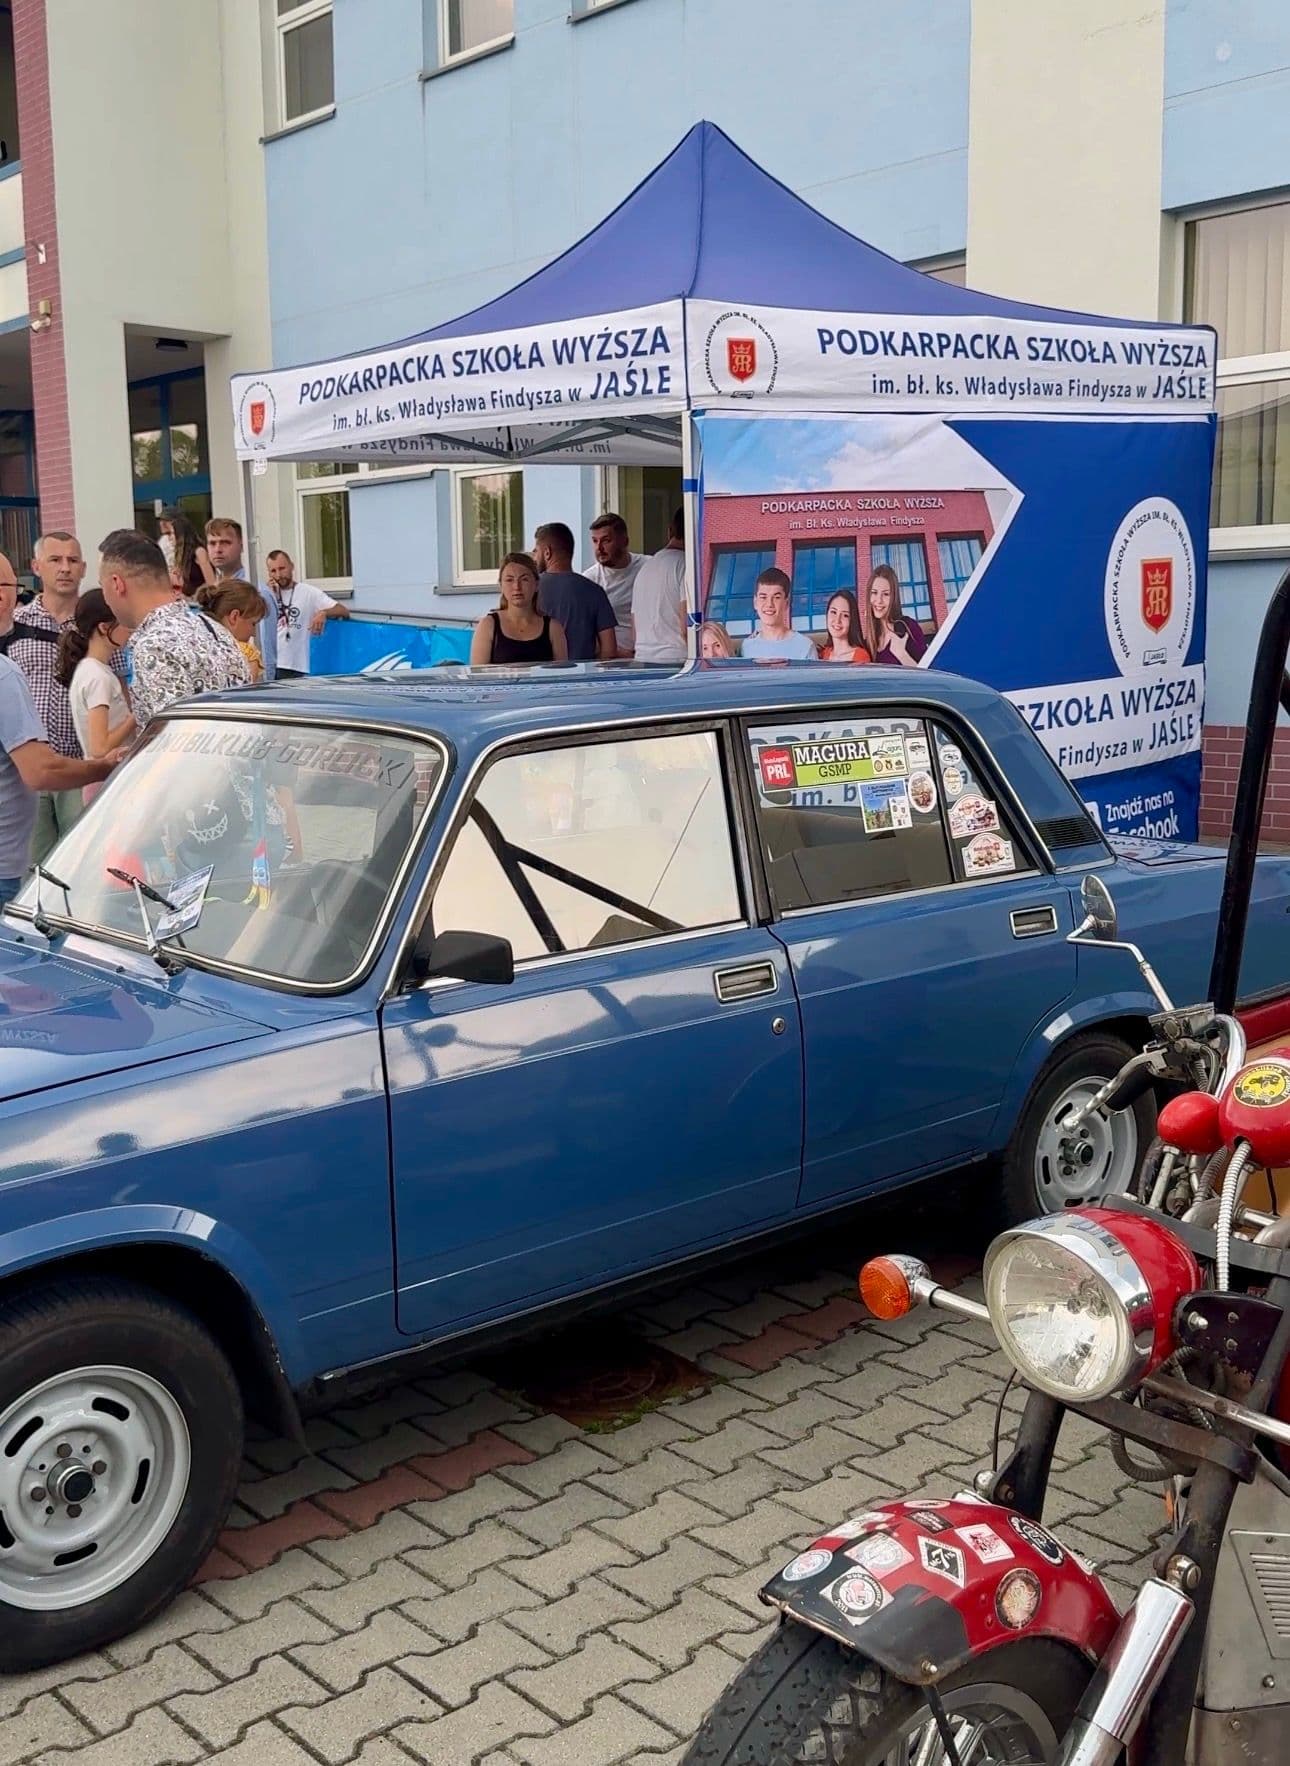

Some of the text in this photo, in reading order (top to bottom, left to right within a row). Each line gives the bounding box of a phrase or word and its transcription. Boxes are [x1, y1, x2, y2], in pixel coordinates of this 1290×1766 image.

[816, 328, 1208, 370] PODKARPACKA SZKOŁA WYŻSZA
[299, 327, 671, 405] PODKARPACKA SZKOŁA WYŻSZA
[333, 359, 672, 432] im. bł. ks. Władysława Findysza w JAŚLE
[872, 369, 1208, 402] im. bł. ks. Władysława Findysza w JAŚLE
[761, 495, 945, 514] PODKARPACKA SZKOŁA WYŻSZA
[789, 520, 802, 530] im.
[820, 518, 834, 529] Ks.
[837, 516, 886, 529] Władysława
[890, 515, 925, 527] Findysza
[1120, 677, 1196, 717] WYŻSZA
[794, 740, 871, 766] MAGURA
[1058, 710, 1194, 767] Findysza w JAŚLE
[766, 762, 791, 781] PRL
[818, 763, 852, 778] GSMP
[1104, 796, 1144, 822] Znajdź
[1144, 794, 1162, 812] nas
[1162, 790, 1175, 808] na
